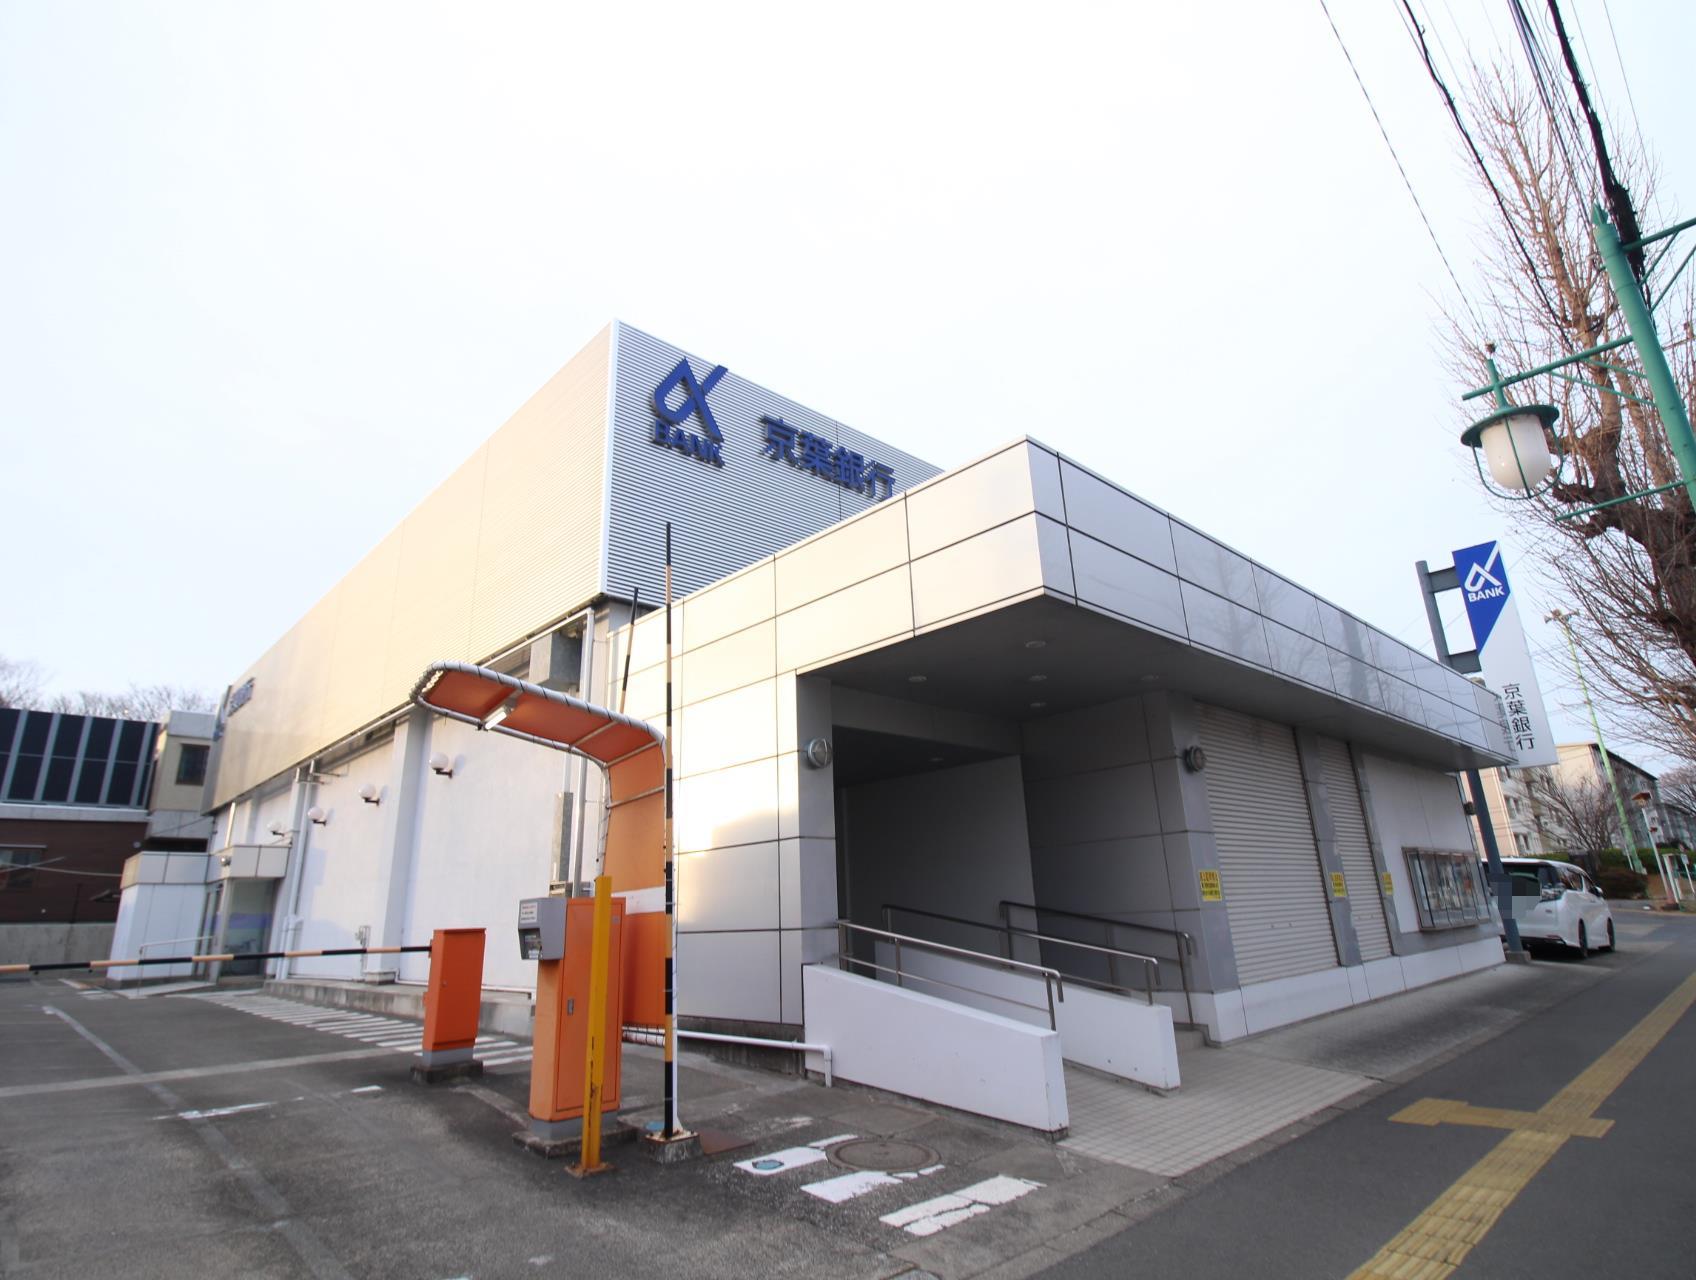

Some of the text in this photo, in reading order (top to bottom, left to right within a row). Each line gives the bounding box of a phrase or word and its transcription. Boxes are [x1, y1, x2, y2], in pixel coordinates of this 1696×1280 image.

[655, 419, 726, 468] BANK
[761, 415, 896, 501] 京葉銀行
[1468, 586, 1505, 602] BANK
[1502, 683, 1534, 750] 京葉銀行
